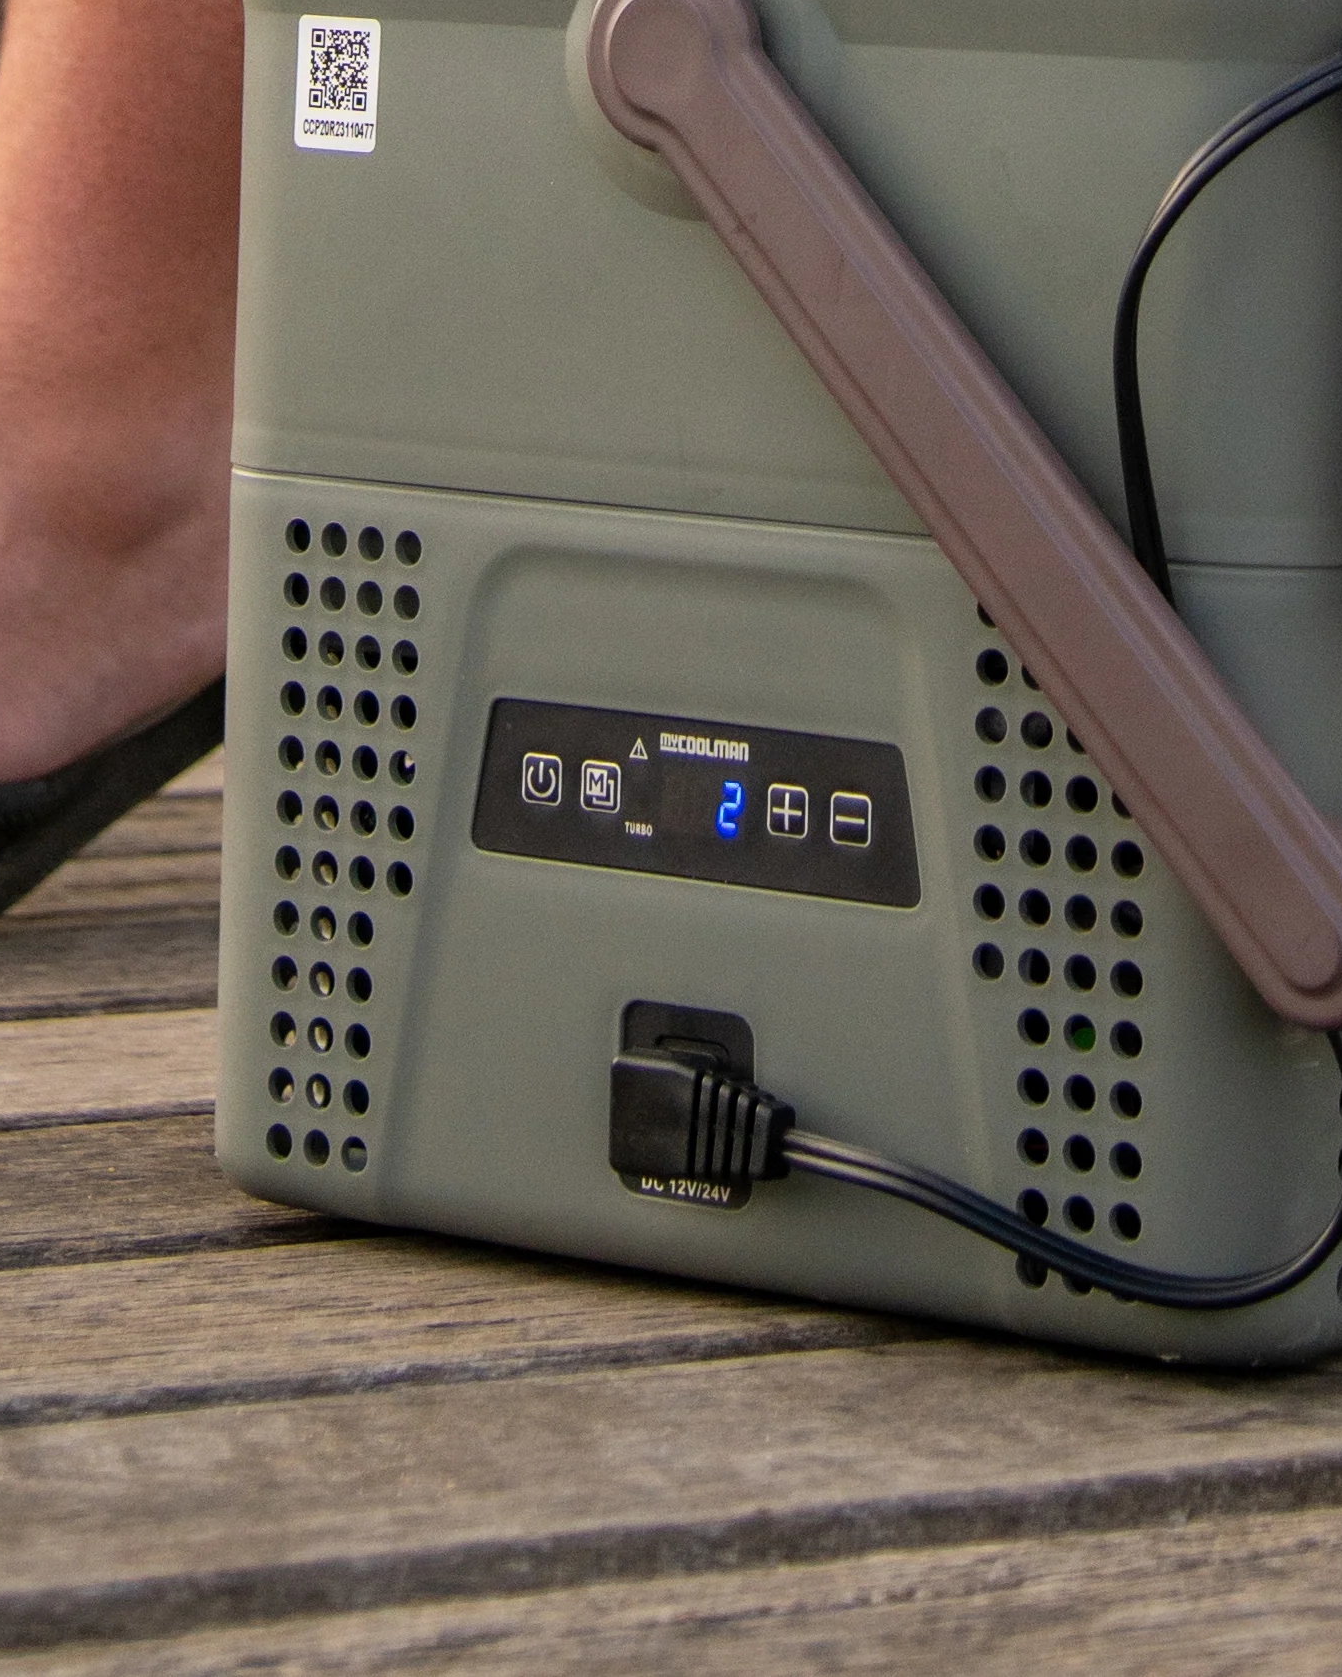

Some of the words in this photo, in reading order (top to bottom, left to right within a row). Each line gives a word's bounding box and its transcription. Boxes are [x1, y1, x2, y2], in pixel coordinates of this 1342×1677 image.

[303, 118, 375, 140] CCP20R23110477
[718, 780, 743, 834] 2
[624, 821, 654, 838] TURBO
[669, 1178, 731, 1203] 12V/24V
